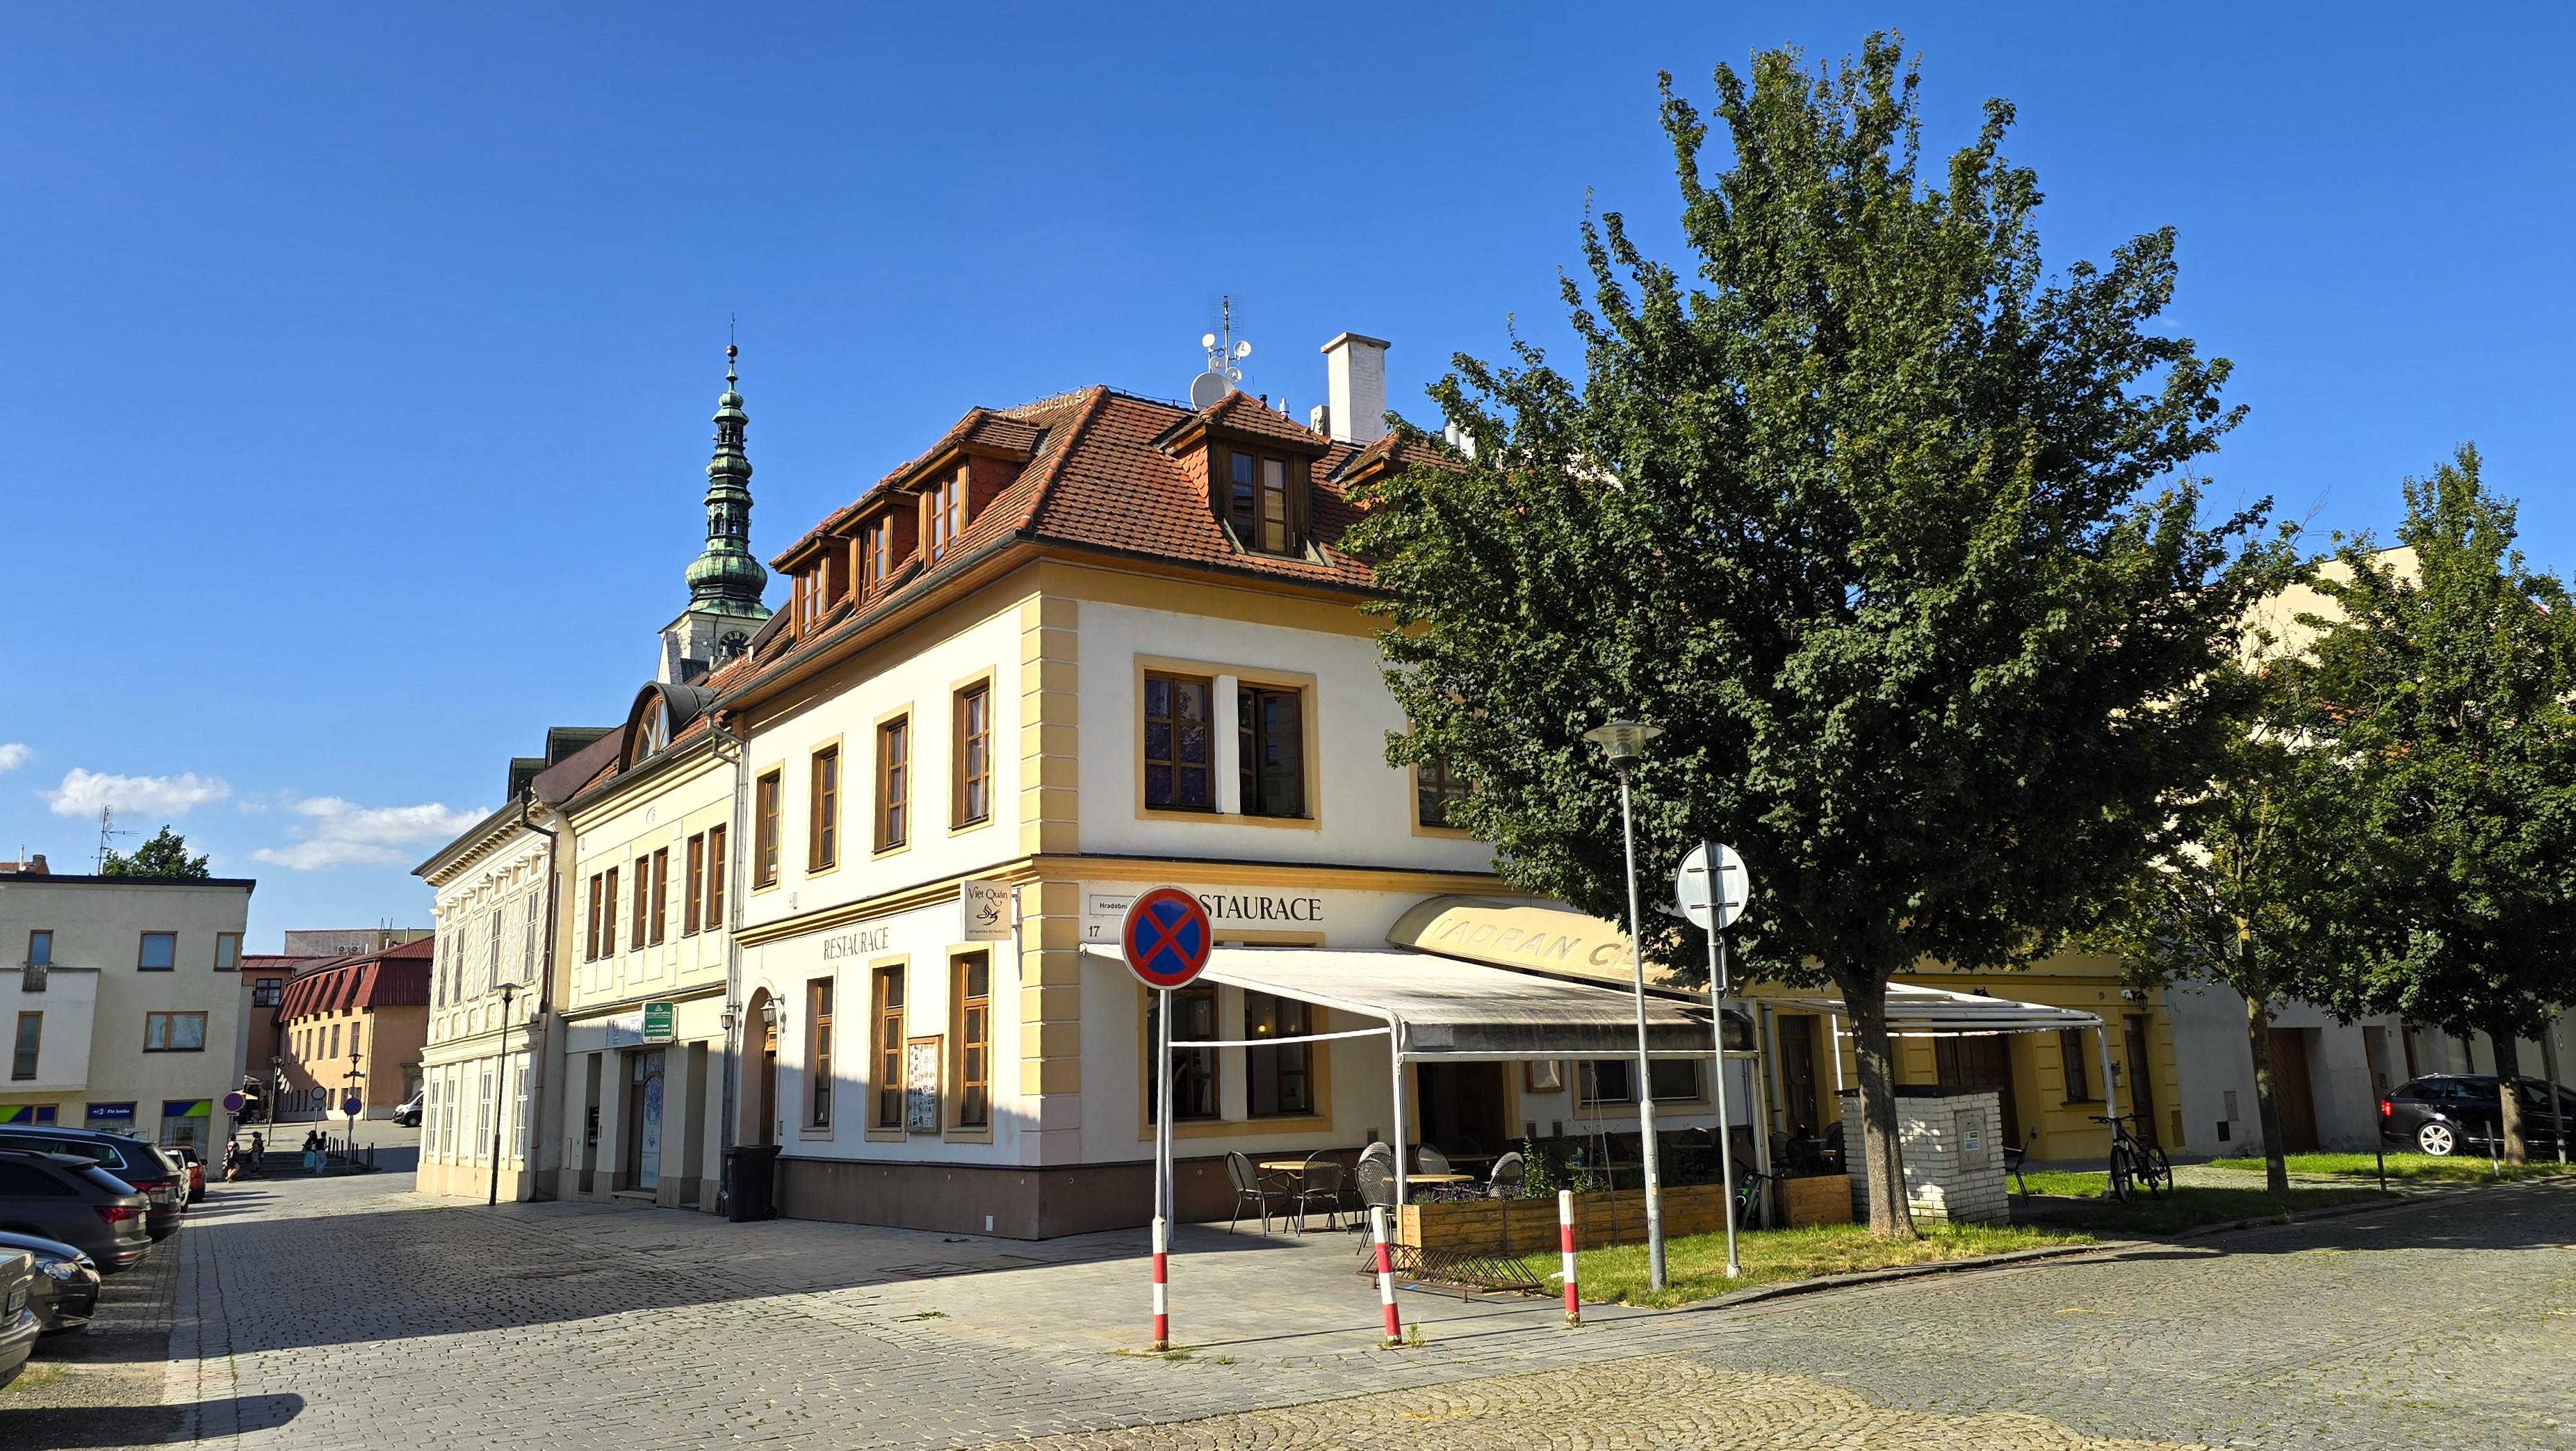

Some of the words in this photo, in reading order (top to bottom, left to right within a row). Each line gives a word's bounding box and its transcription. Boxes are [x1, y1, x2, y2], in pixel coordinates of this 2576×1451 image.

[1199, 894, 1323, 921] STAURACE
[824, 927, 889, 960] RESTAURACE
[1089, 925, 1100, 937] 17
